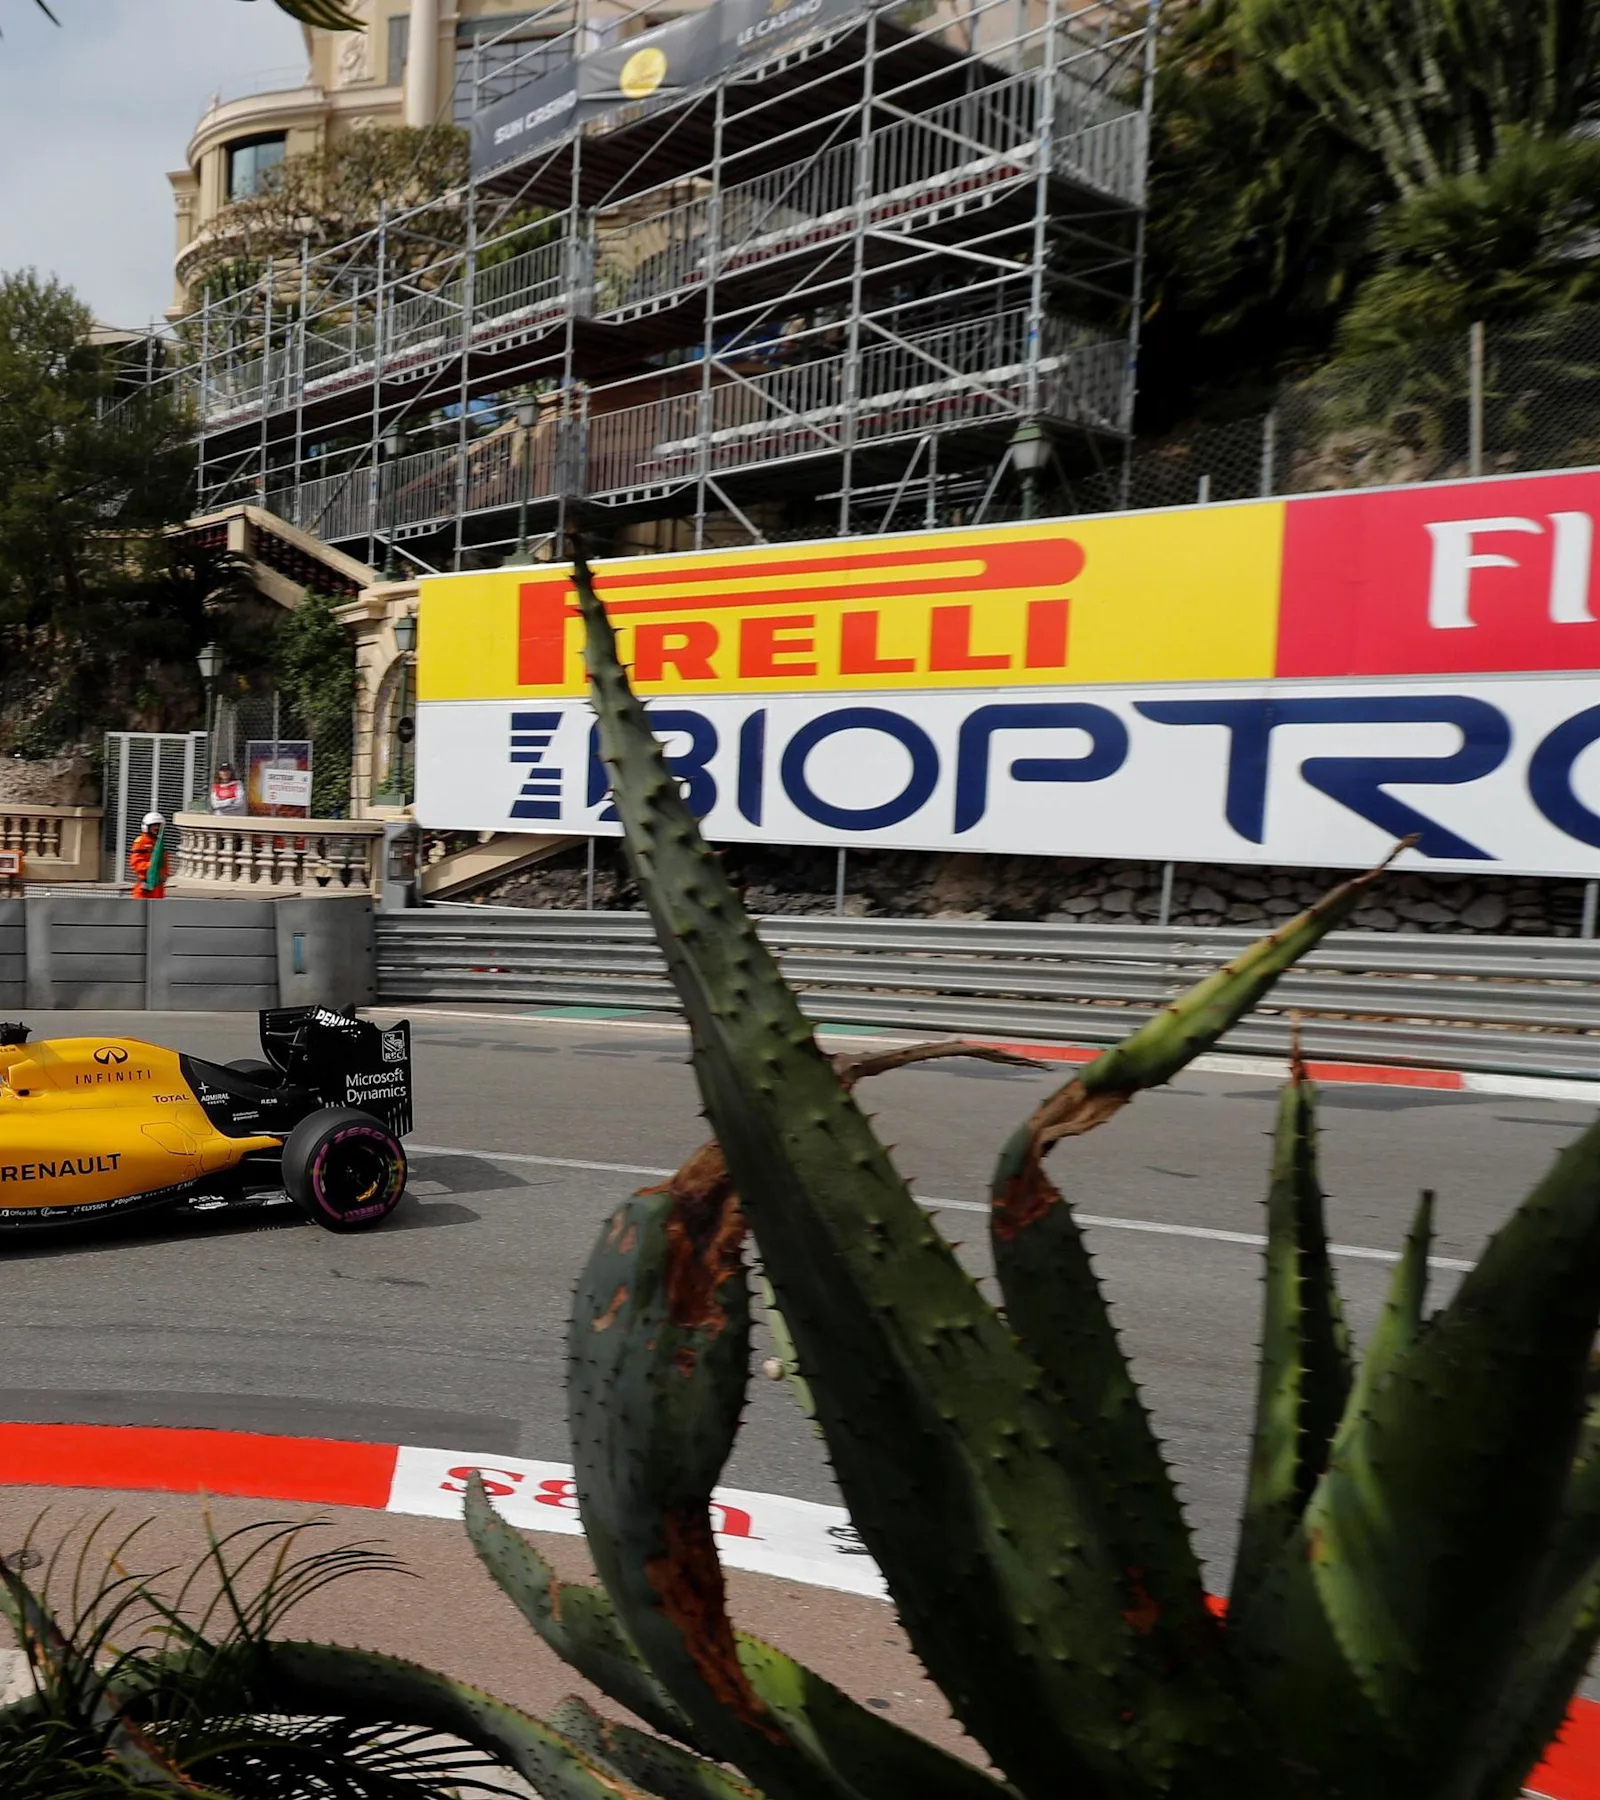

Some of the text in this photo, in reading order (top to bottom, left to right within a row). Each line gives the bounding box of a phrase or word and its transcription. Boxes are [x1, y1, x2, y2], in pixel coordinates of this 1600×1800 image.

[518, 538, 1087, 685] PIRELLI
[75, 1068, 152, 1085] INFINITI
[345, 1067, 405, 1088] Microsoft
[346, 1083, 407, 1106] Dynamics
[0, 1152, 122, 1182] RENAULT
